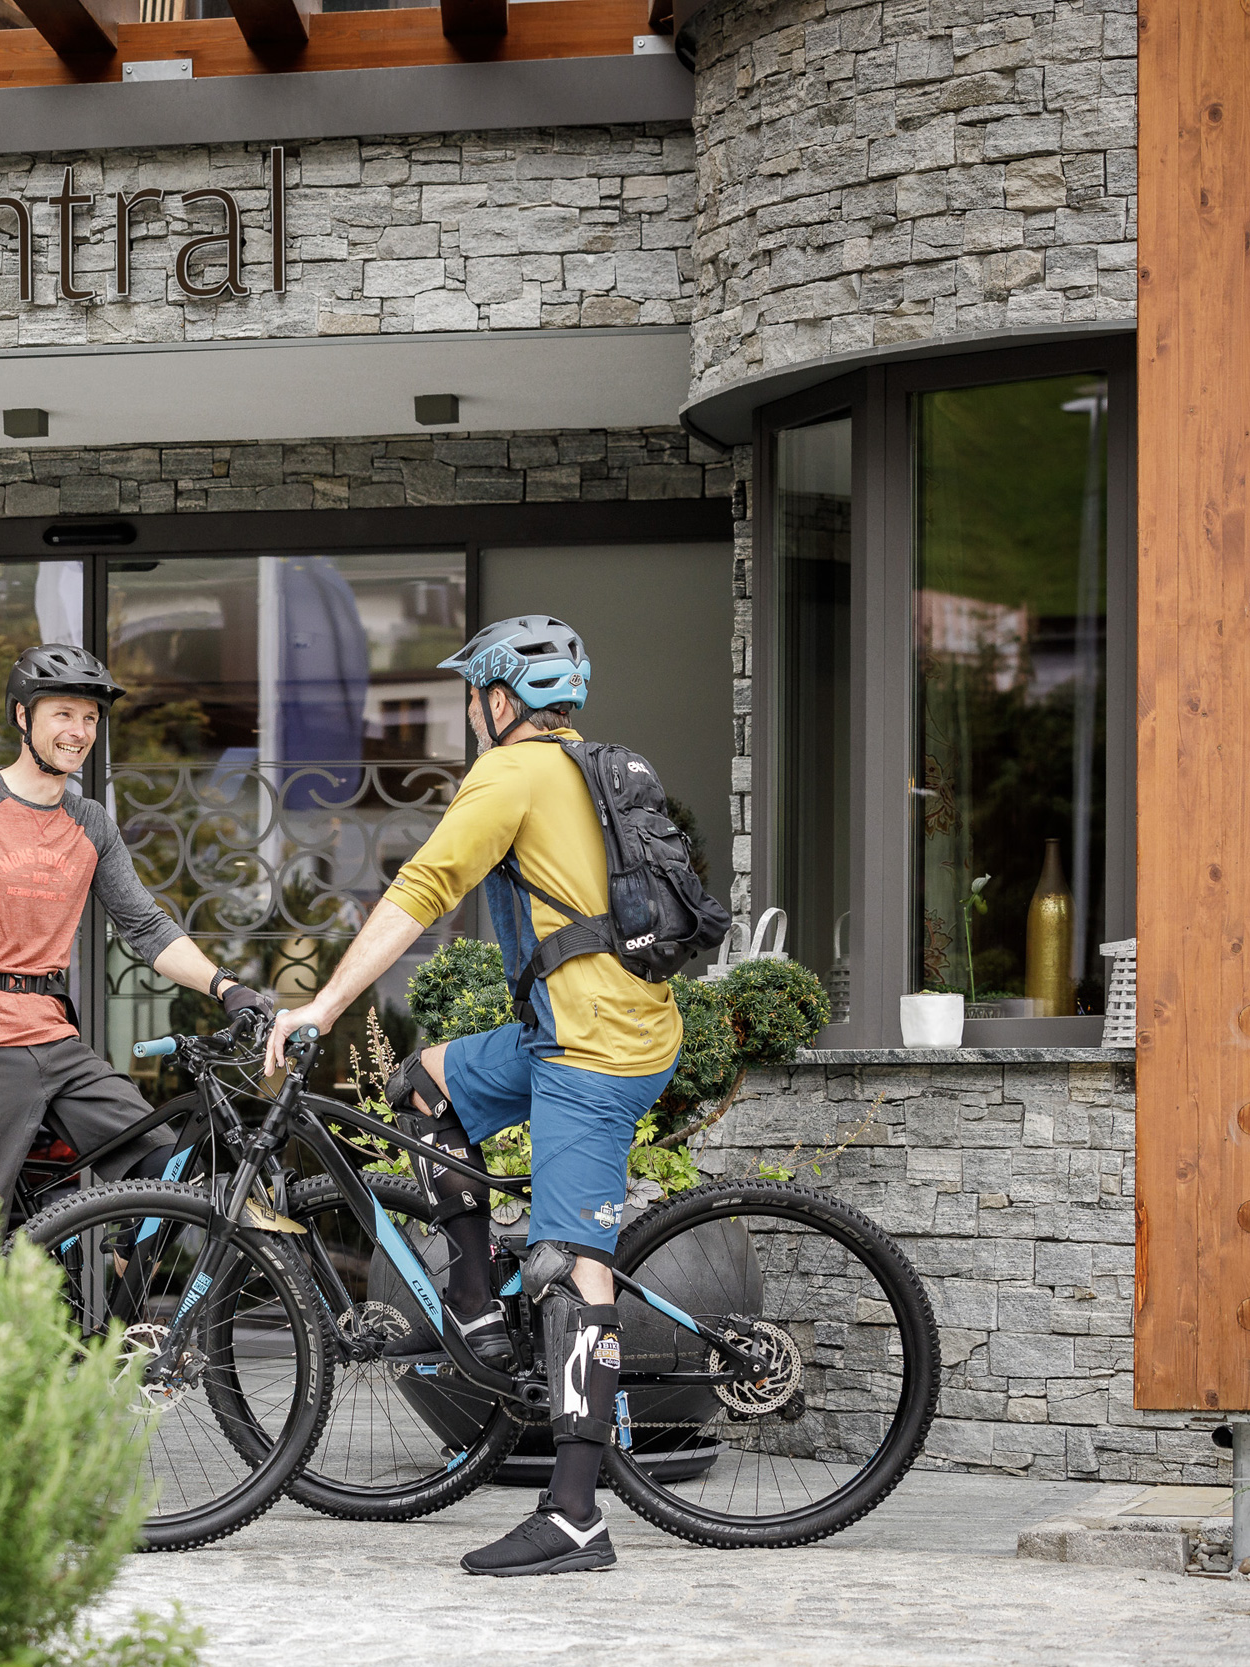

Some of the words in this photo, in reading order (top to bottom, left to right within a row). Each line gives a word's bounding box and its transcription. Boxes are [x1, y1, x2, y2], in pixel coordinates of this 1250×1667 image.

[37, 847, 77, 882] ROYALE
[626, 933, 656, 950] evoc
[797, 1203, 873, 1250] NOBBY
[283, 1275, 307, 1309] NIC
[412, 1280, 439, 1316] CUBE
[303, 1318, 318, 1405] NOBBY
[388, 1443, 490, 1508] SCHWALBE
[651, 1498, 781, 1536] SCHWALBE
